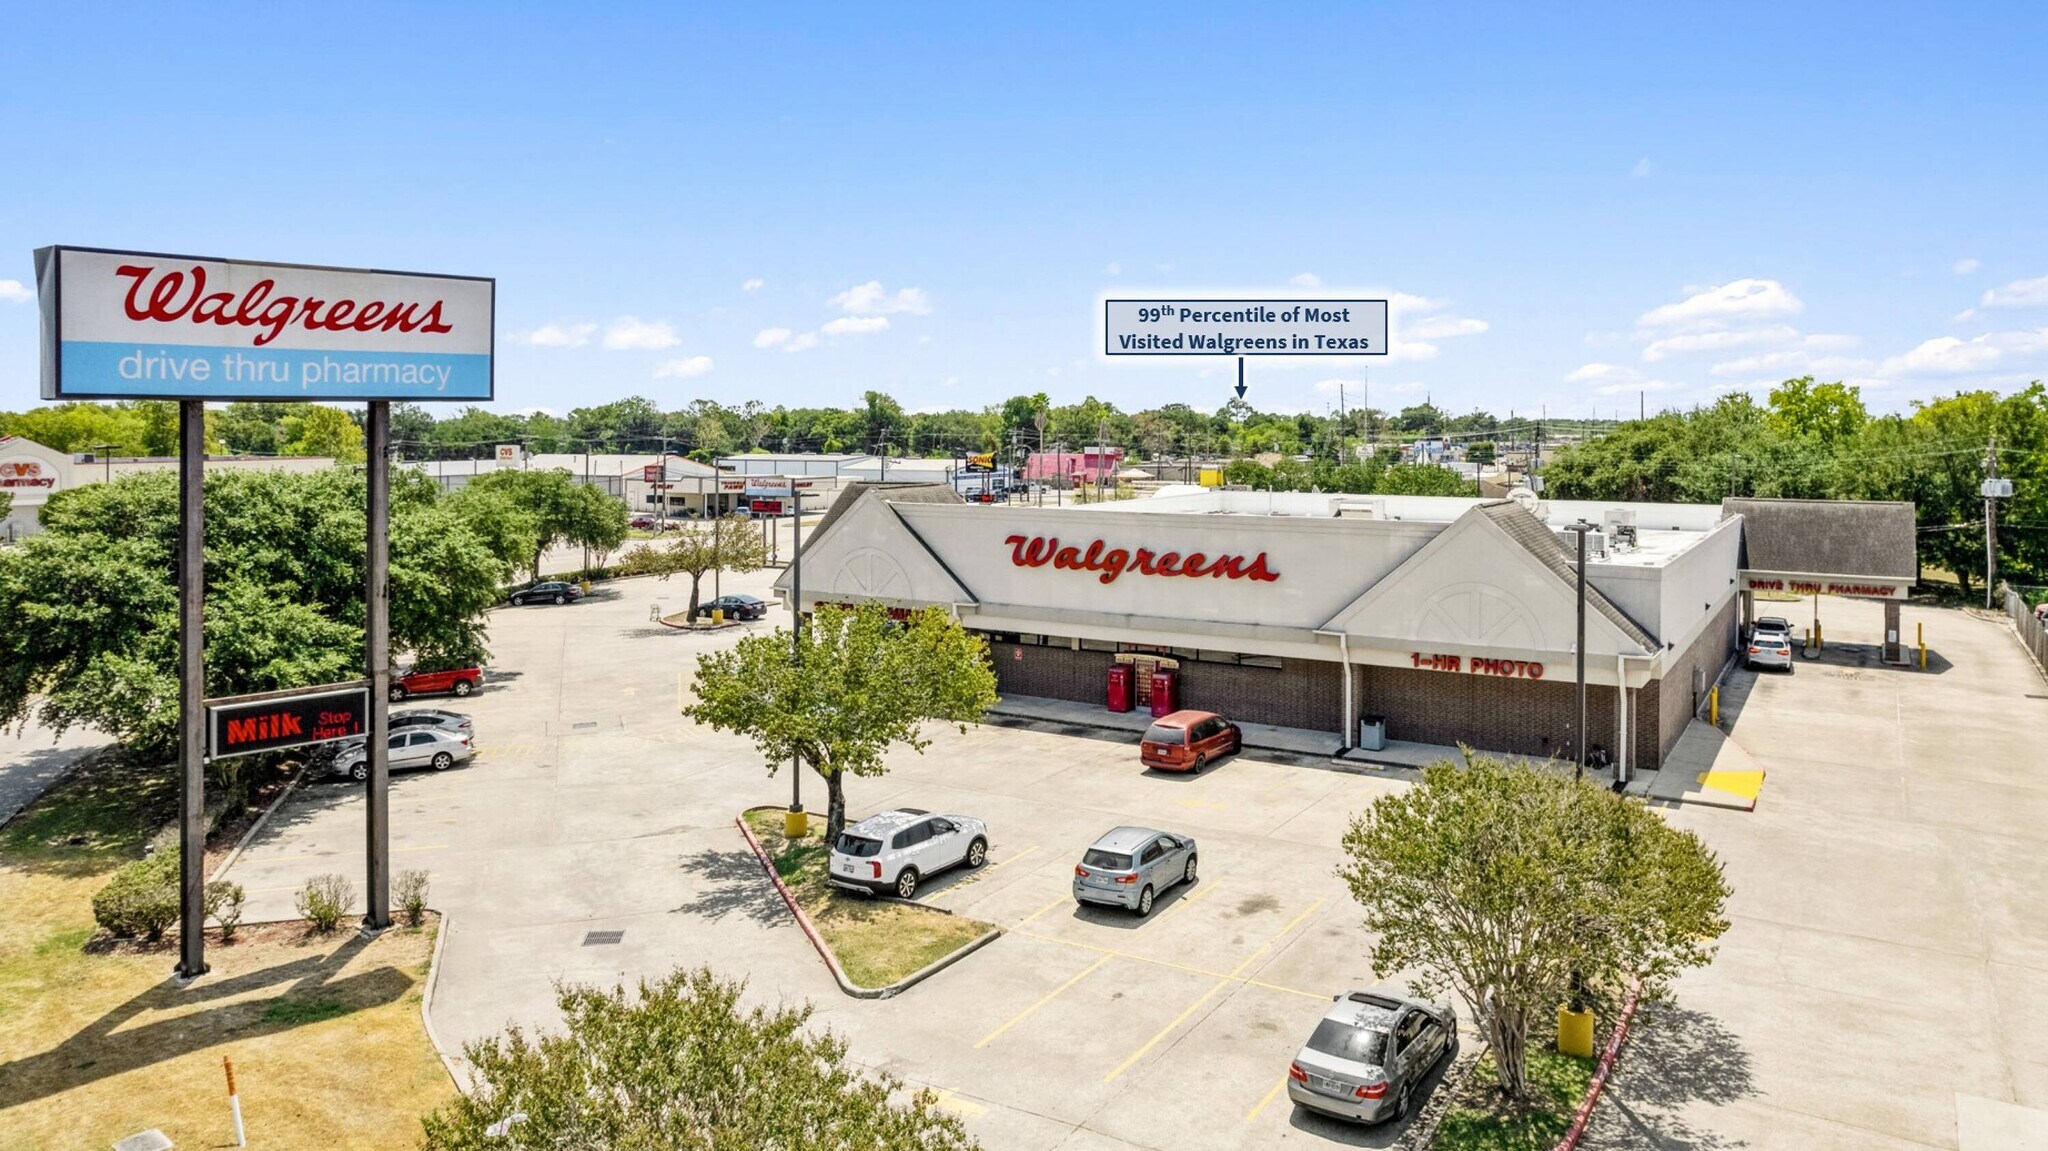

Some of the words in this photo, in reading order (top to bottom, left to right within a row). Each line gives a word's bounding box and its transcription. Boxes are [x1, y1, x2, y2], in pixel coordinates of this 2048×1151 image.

[116, 265, 453, 345] Walgreens
[118, 349, 211, 381] drive
[222, 353, 290, 382] thru
[302, 355, 452, 390] pharmacy
[968, 456, 992, 464] SONIC
[0, 463, 41, 477] CVS
[0, 478, 55, 489] armacy
[751, 478, 787, 490] Walgreens
[1005, 535, 1280, 584] Walgreens
[1749, 579, 1784, 591] DRIVE
[1789, 580, 1822, 593] THRU
[1828, 583, 1897, 596] PHARMACY
[1411, 652, 1461, 672] 1-HR
[1470, 657, 1544, 679] PHOTO
[318, 711, 352, 726] Stop
[227, 712, 302, 745] Milk
[312, 726, 347, 741] Here
